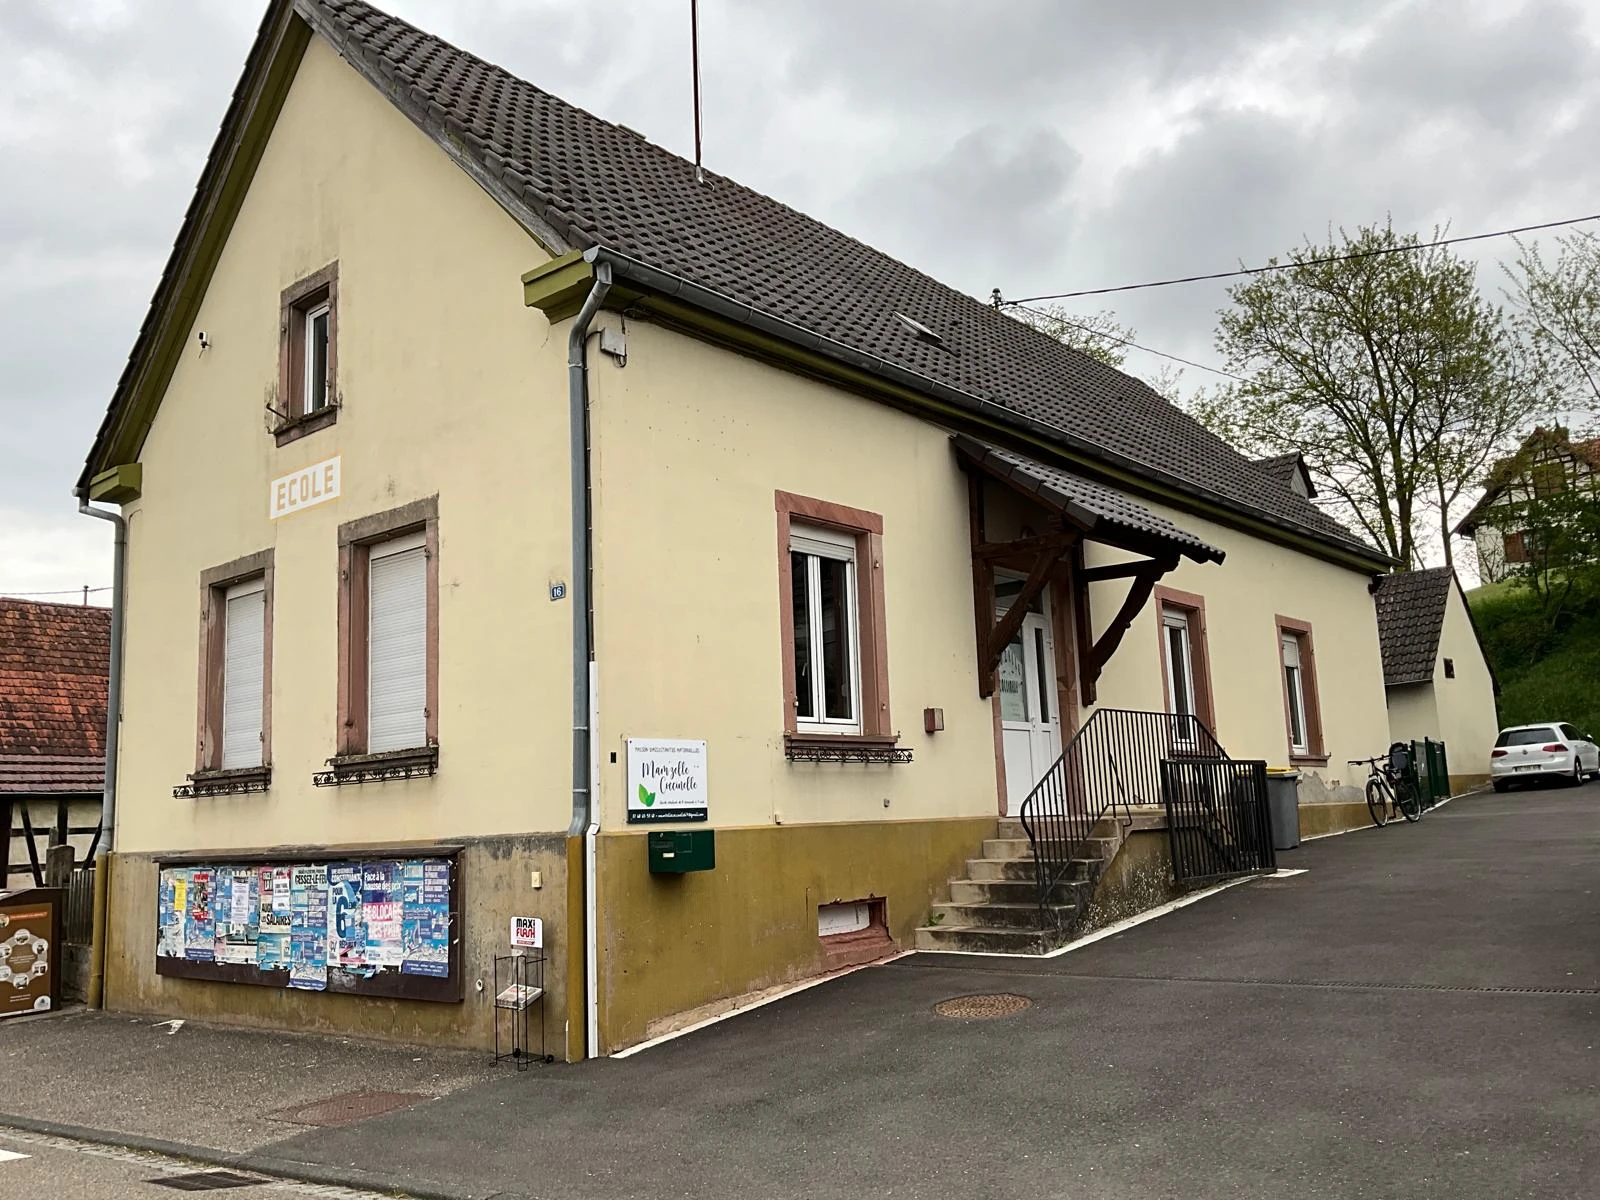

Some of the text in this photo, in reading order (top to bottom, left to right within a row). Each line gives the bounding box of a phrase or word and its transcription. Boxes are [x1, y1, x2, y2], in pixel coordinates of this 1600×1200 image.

[276, 464, 334, 511] ECOLE
[553, 586, 563, 597] 16
[364, 871, 376, 881] Face
[380, 872, 385, 881] la
[516, 927, 536, 939] FLASH
